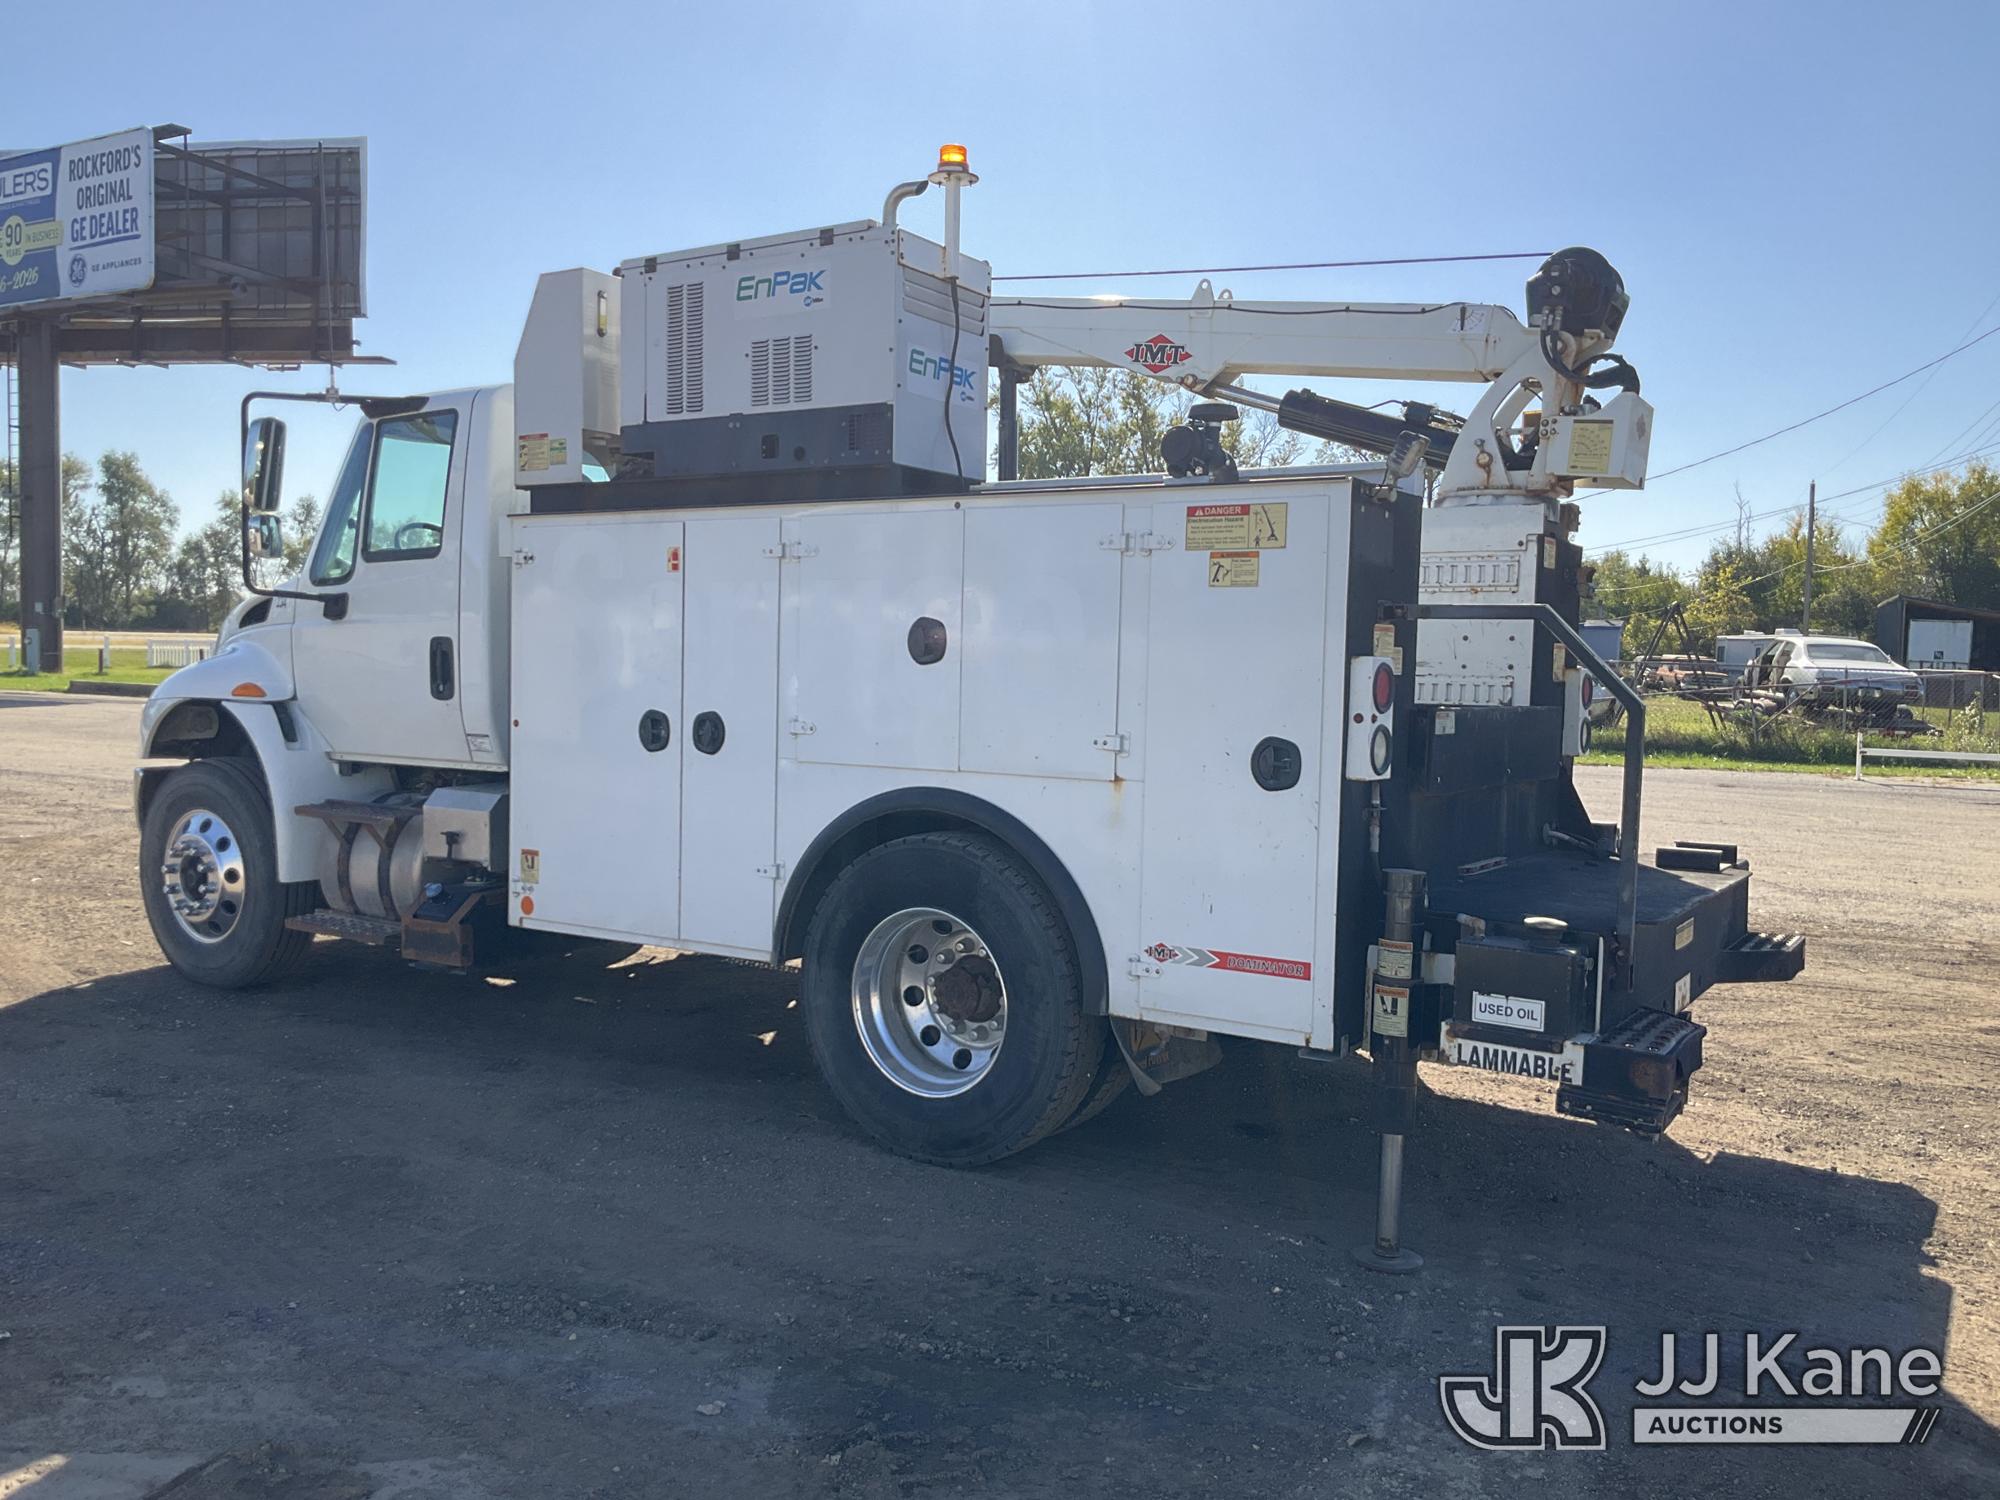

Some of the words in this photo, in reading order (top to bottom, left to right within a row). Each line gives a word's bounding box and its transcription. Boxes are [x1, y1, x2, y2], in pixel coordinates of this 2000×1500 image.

[69, 144, 141, 182] ROCKFORD'S
[77, 177, 133, 210] ORIGINAL
[5, 223, 22, 247] 90
[71, 216, 87, 242] GE
[89, 207, 139, 240] DEALER
[102, 257, 142, 270] APPLIANCES
[736, 270, 826, 301] EnPak
[1132, 343, 1185, 365] IMT
[1204, 506, 1241, 515] DANGER
[1147, 946, 1175, 960] IMT
[1227, 956, 1304, 976] DOMINATOR
[1479, 1002, 1513, 1017] USED
[1517, 1008, 1538, 1020] OIL
